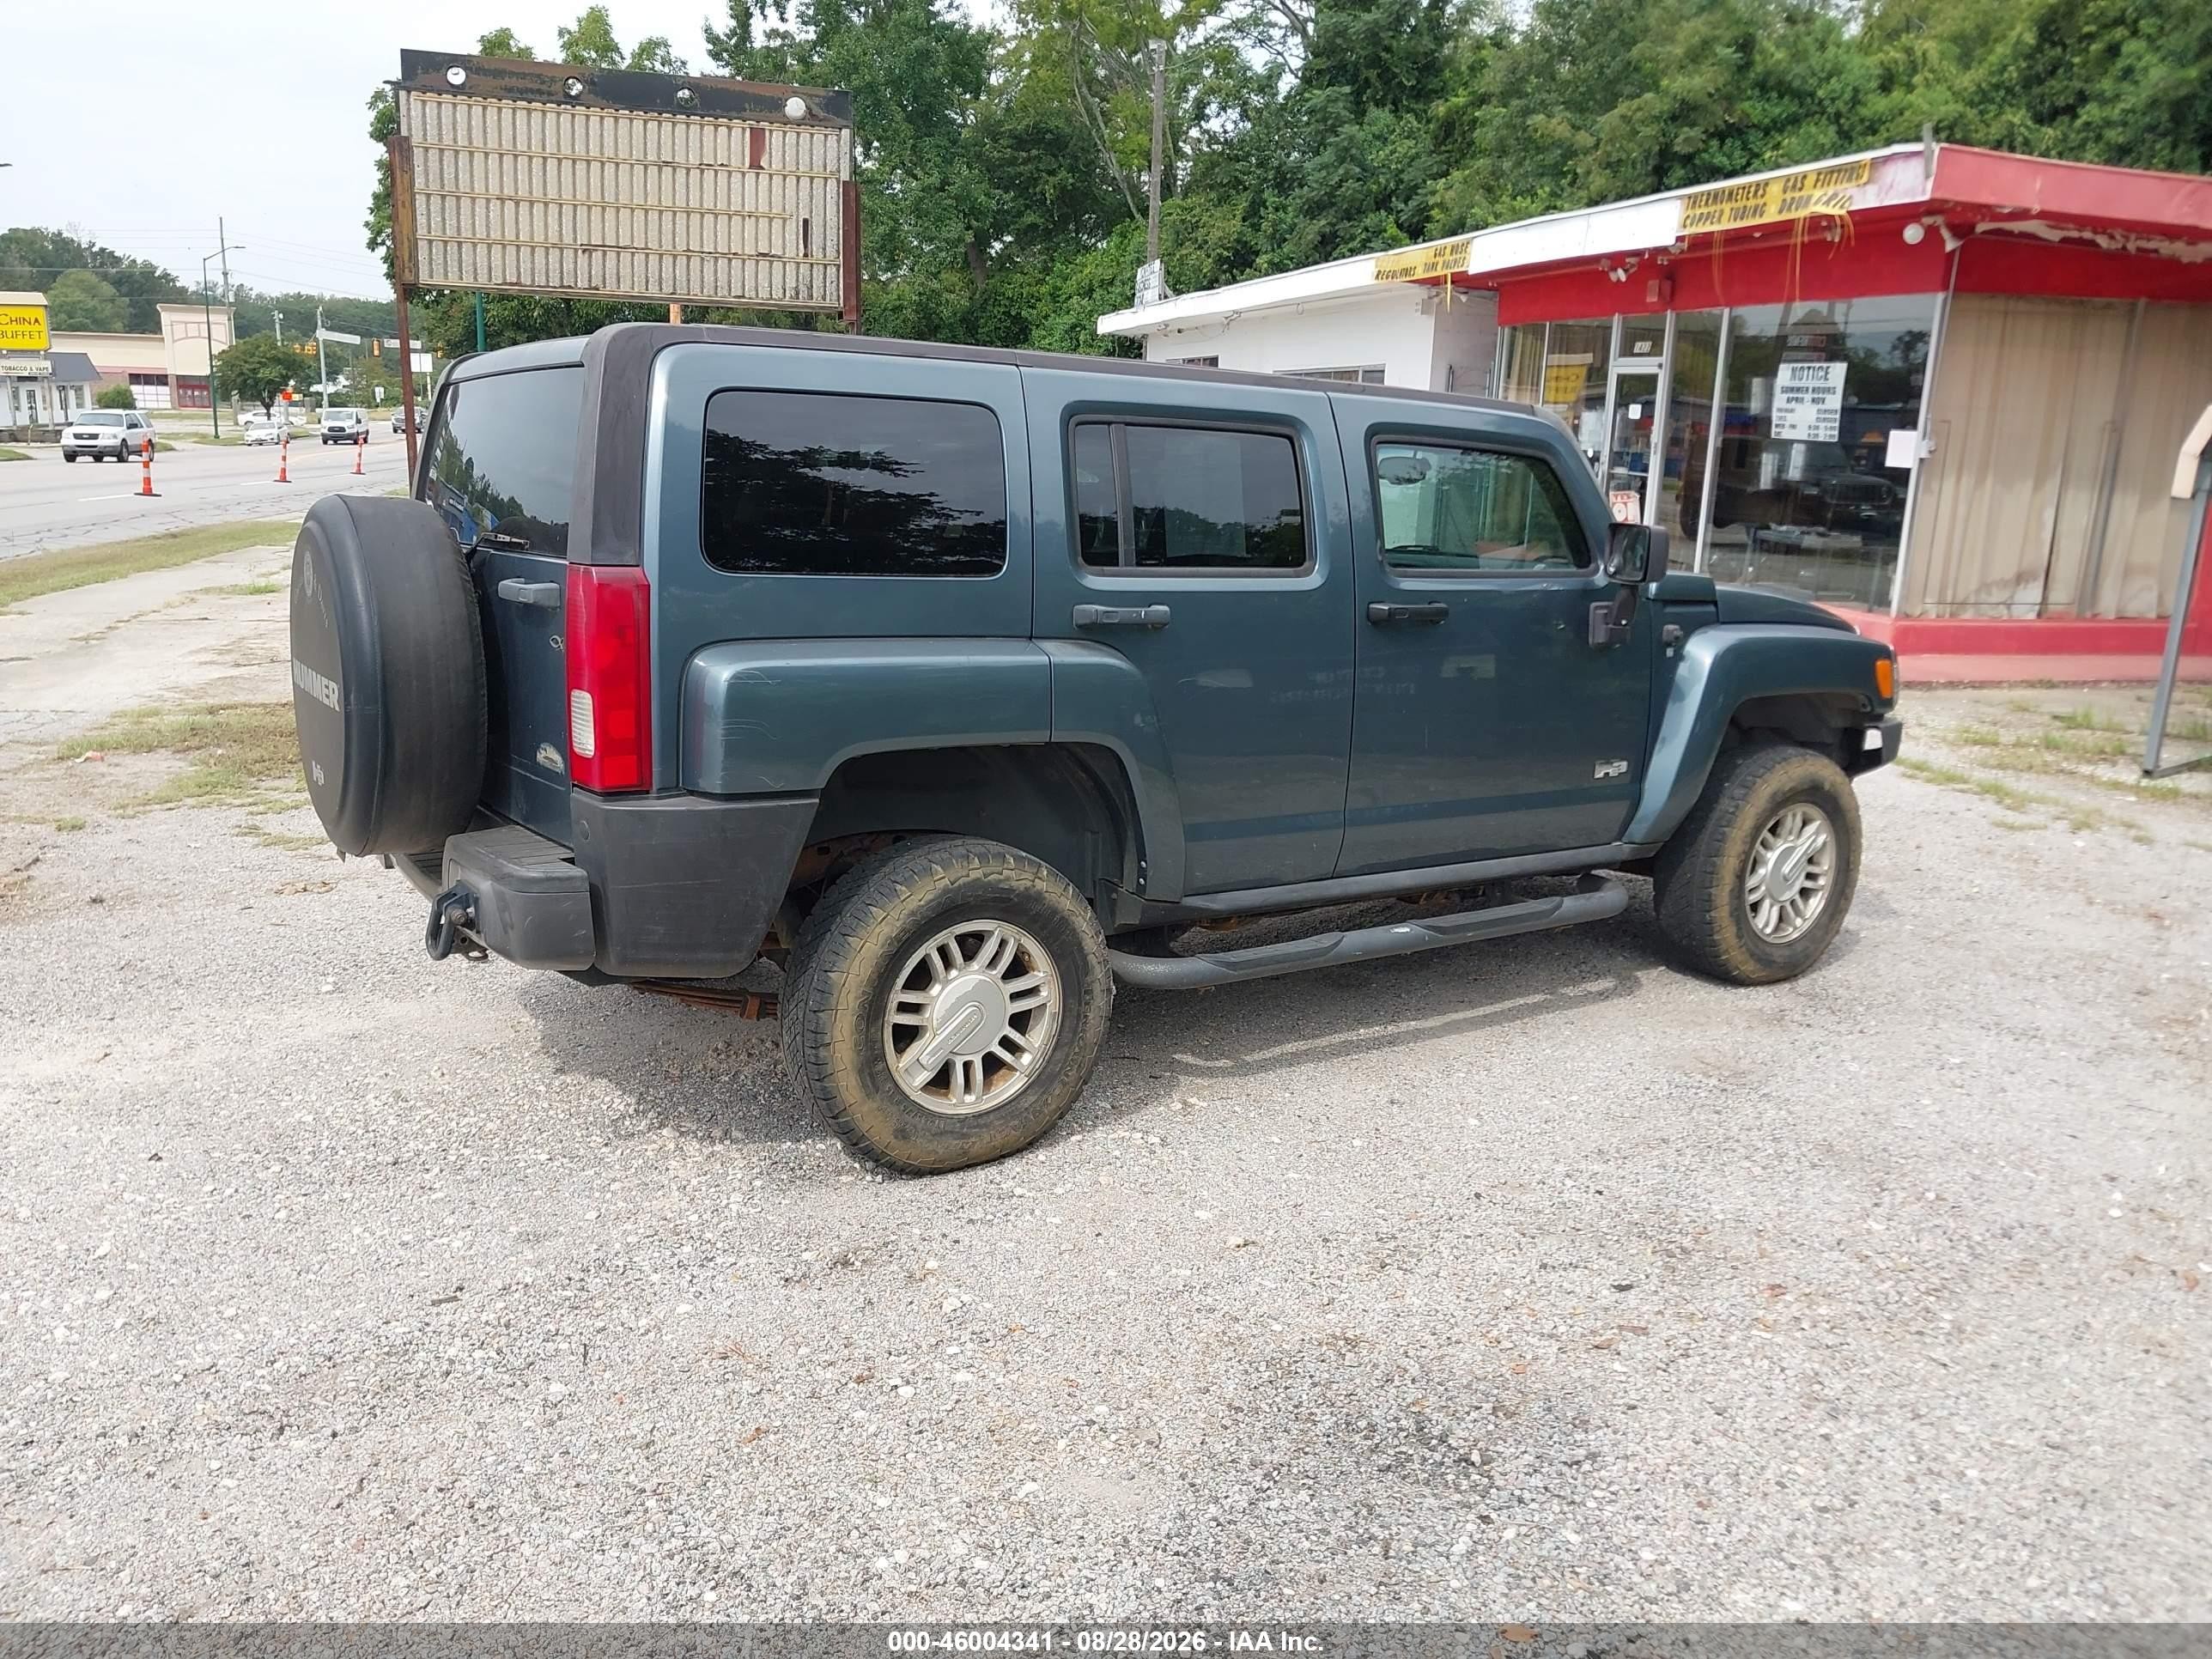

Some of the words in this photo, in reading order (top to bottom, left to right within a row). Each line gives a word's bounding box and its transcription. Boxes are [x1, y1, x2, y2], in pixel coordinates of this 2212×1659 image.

[1686, 181, 1769, 210] THERMOMETERS
[1783, 173, 1808, 194] GAS
[1683, 209, 1724, 228] COPPER
[1728, 202, 1767, 222] TUBING
[1434, 246, 1448, 259] GAS
[1449, 241, 1470, 256] HOSE
[1375, 265, 1417, 281] REGULATORS
[0, 313, 41, 325] CHINA
[0, 330, 43, 339] BUFFET
[1790, 366, 1831, 382] NOTICE
[1780, 386, 1809, 395] SUMMER
[1811, 386, 1837, 395] HOURS
[1786, 396, 1805, 404] APRIL
[293, 656, 340, 712] HUMMER
